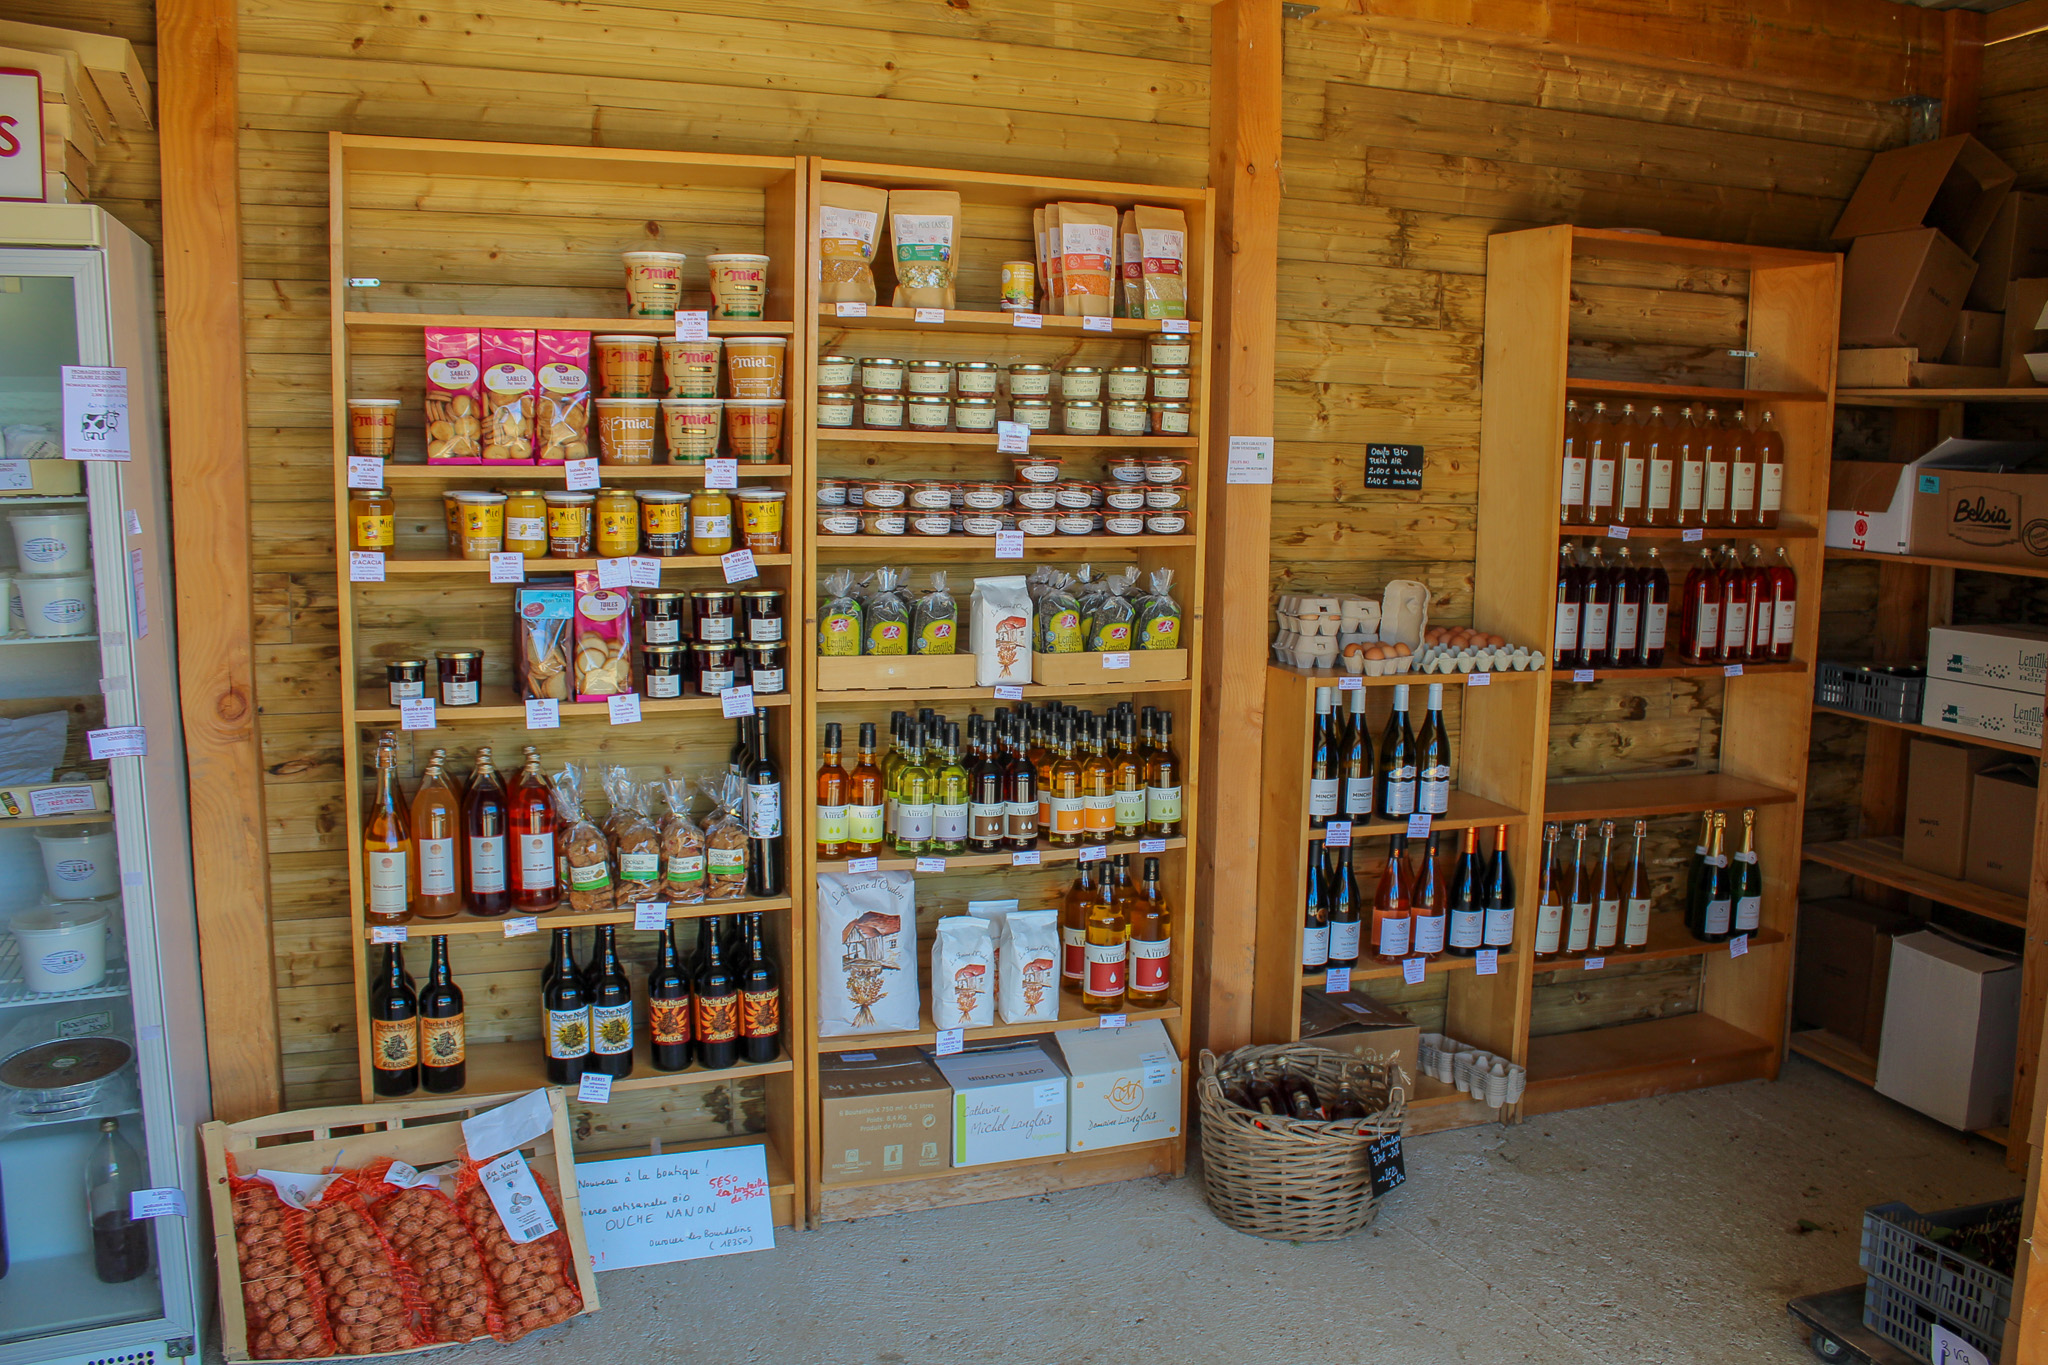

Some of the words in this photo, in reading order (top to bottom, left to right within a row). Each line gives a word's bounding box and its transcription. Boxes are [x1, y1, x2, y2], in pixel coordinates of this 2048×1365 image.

[1392, 446, 1409, 457] Bio
[1953, 496, 2012, 524] Belsia
[826, 636, 853, 648] Lentilles
[876, 642, 903, 654] Lentilles
[928, 641, 954, 653] Lentilles
[831, 888, 845, 906] La
[844, 882, 870, 896] Farine
[871, 878, 906, 901] d'Oudon
[827, 1076, 933, 1091] MINCHIN
[962, 1101, 1001, 1118] Catherine
[860, 1124, 883, 1132] Produit
[892, 1121, 913, 1130] France
[970, 1114, 1011, 1135] Michel
[1010, 1110, 1053, 1140] Langlois
[1118, 1107, 1157, 1132] Langlois
[578, 1177, 619, 1189] Nouveau
[624, 1171, 632, 1183] à
[638, 1168, 650, 1181] la
[656, 1162, 700, 1180] boutique
[605, 1212, 655, 1232] OUCHE
[665, 1201, 717, 1220] NANON
